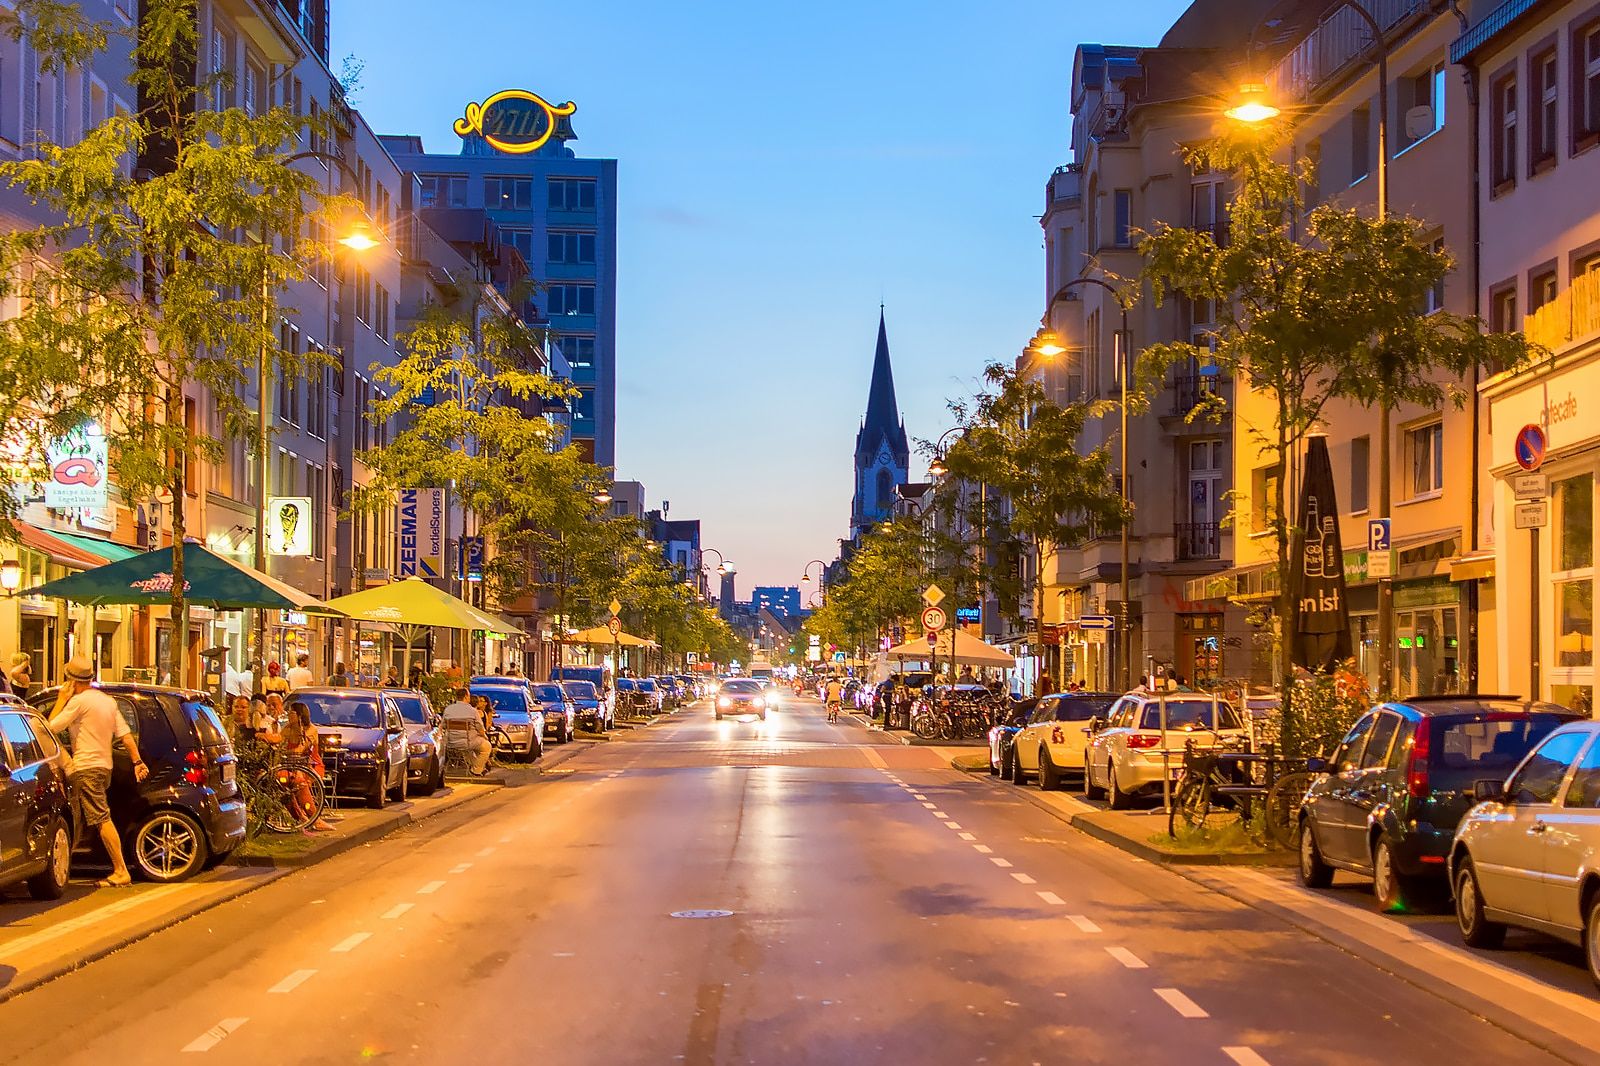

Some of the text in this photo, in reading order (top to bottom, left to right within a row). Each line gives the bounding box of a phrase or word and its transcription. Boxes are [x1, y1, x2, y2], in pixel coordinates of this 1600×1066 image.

[401, 489, 416, 576] ZEEMAN
[430, 490, 441, 555] textielSupers
[1371, 523, 1385, 550] P
[1320, 588, 1339, 612] ist
[926, 613, 940, 625] 30
[211, 660, 220, 672] P
[1157, 665, 1165, 675] P
